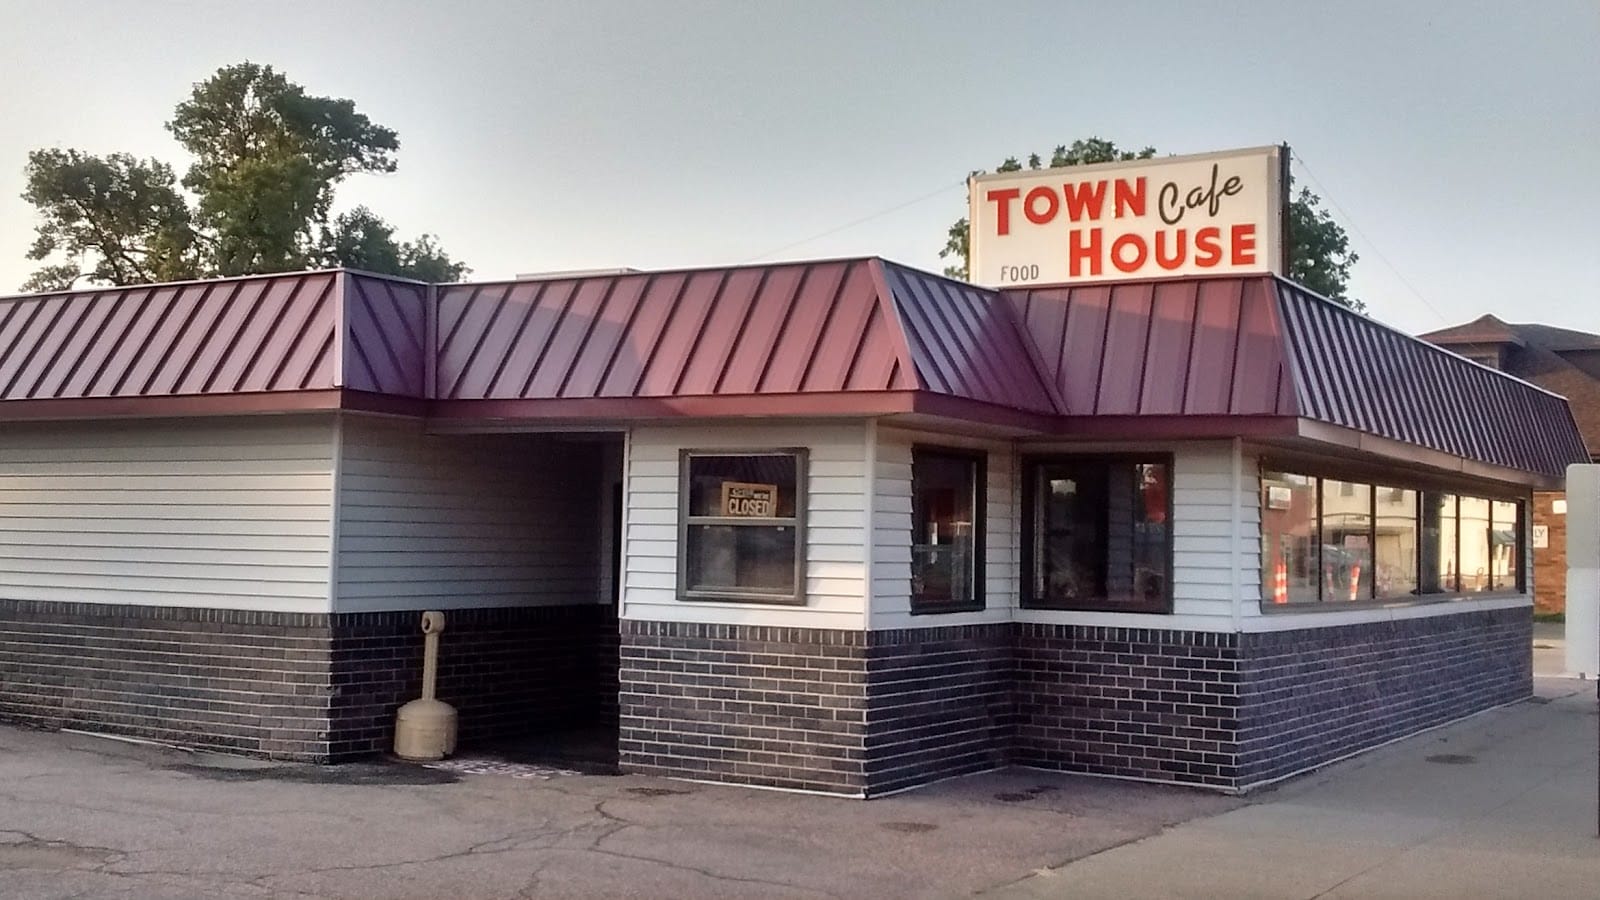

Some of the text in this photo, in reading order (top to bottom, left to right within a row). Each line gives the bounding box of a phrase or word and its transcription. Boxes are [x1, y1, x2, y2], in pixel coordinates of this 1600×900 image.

[987, 176, 1147, 236] TOWN
[1158, 163, 1244, 225] Cafe
[1000, 264, 1040, 282] FOOD
[1069, 224, 1256, 277] HOUSE
[729, 498, 769, 515] CLOSED
